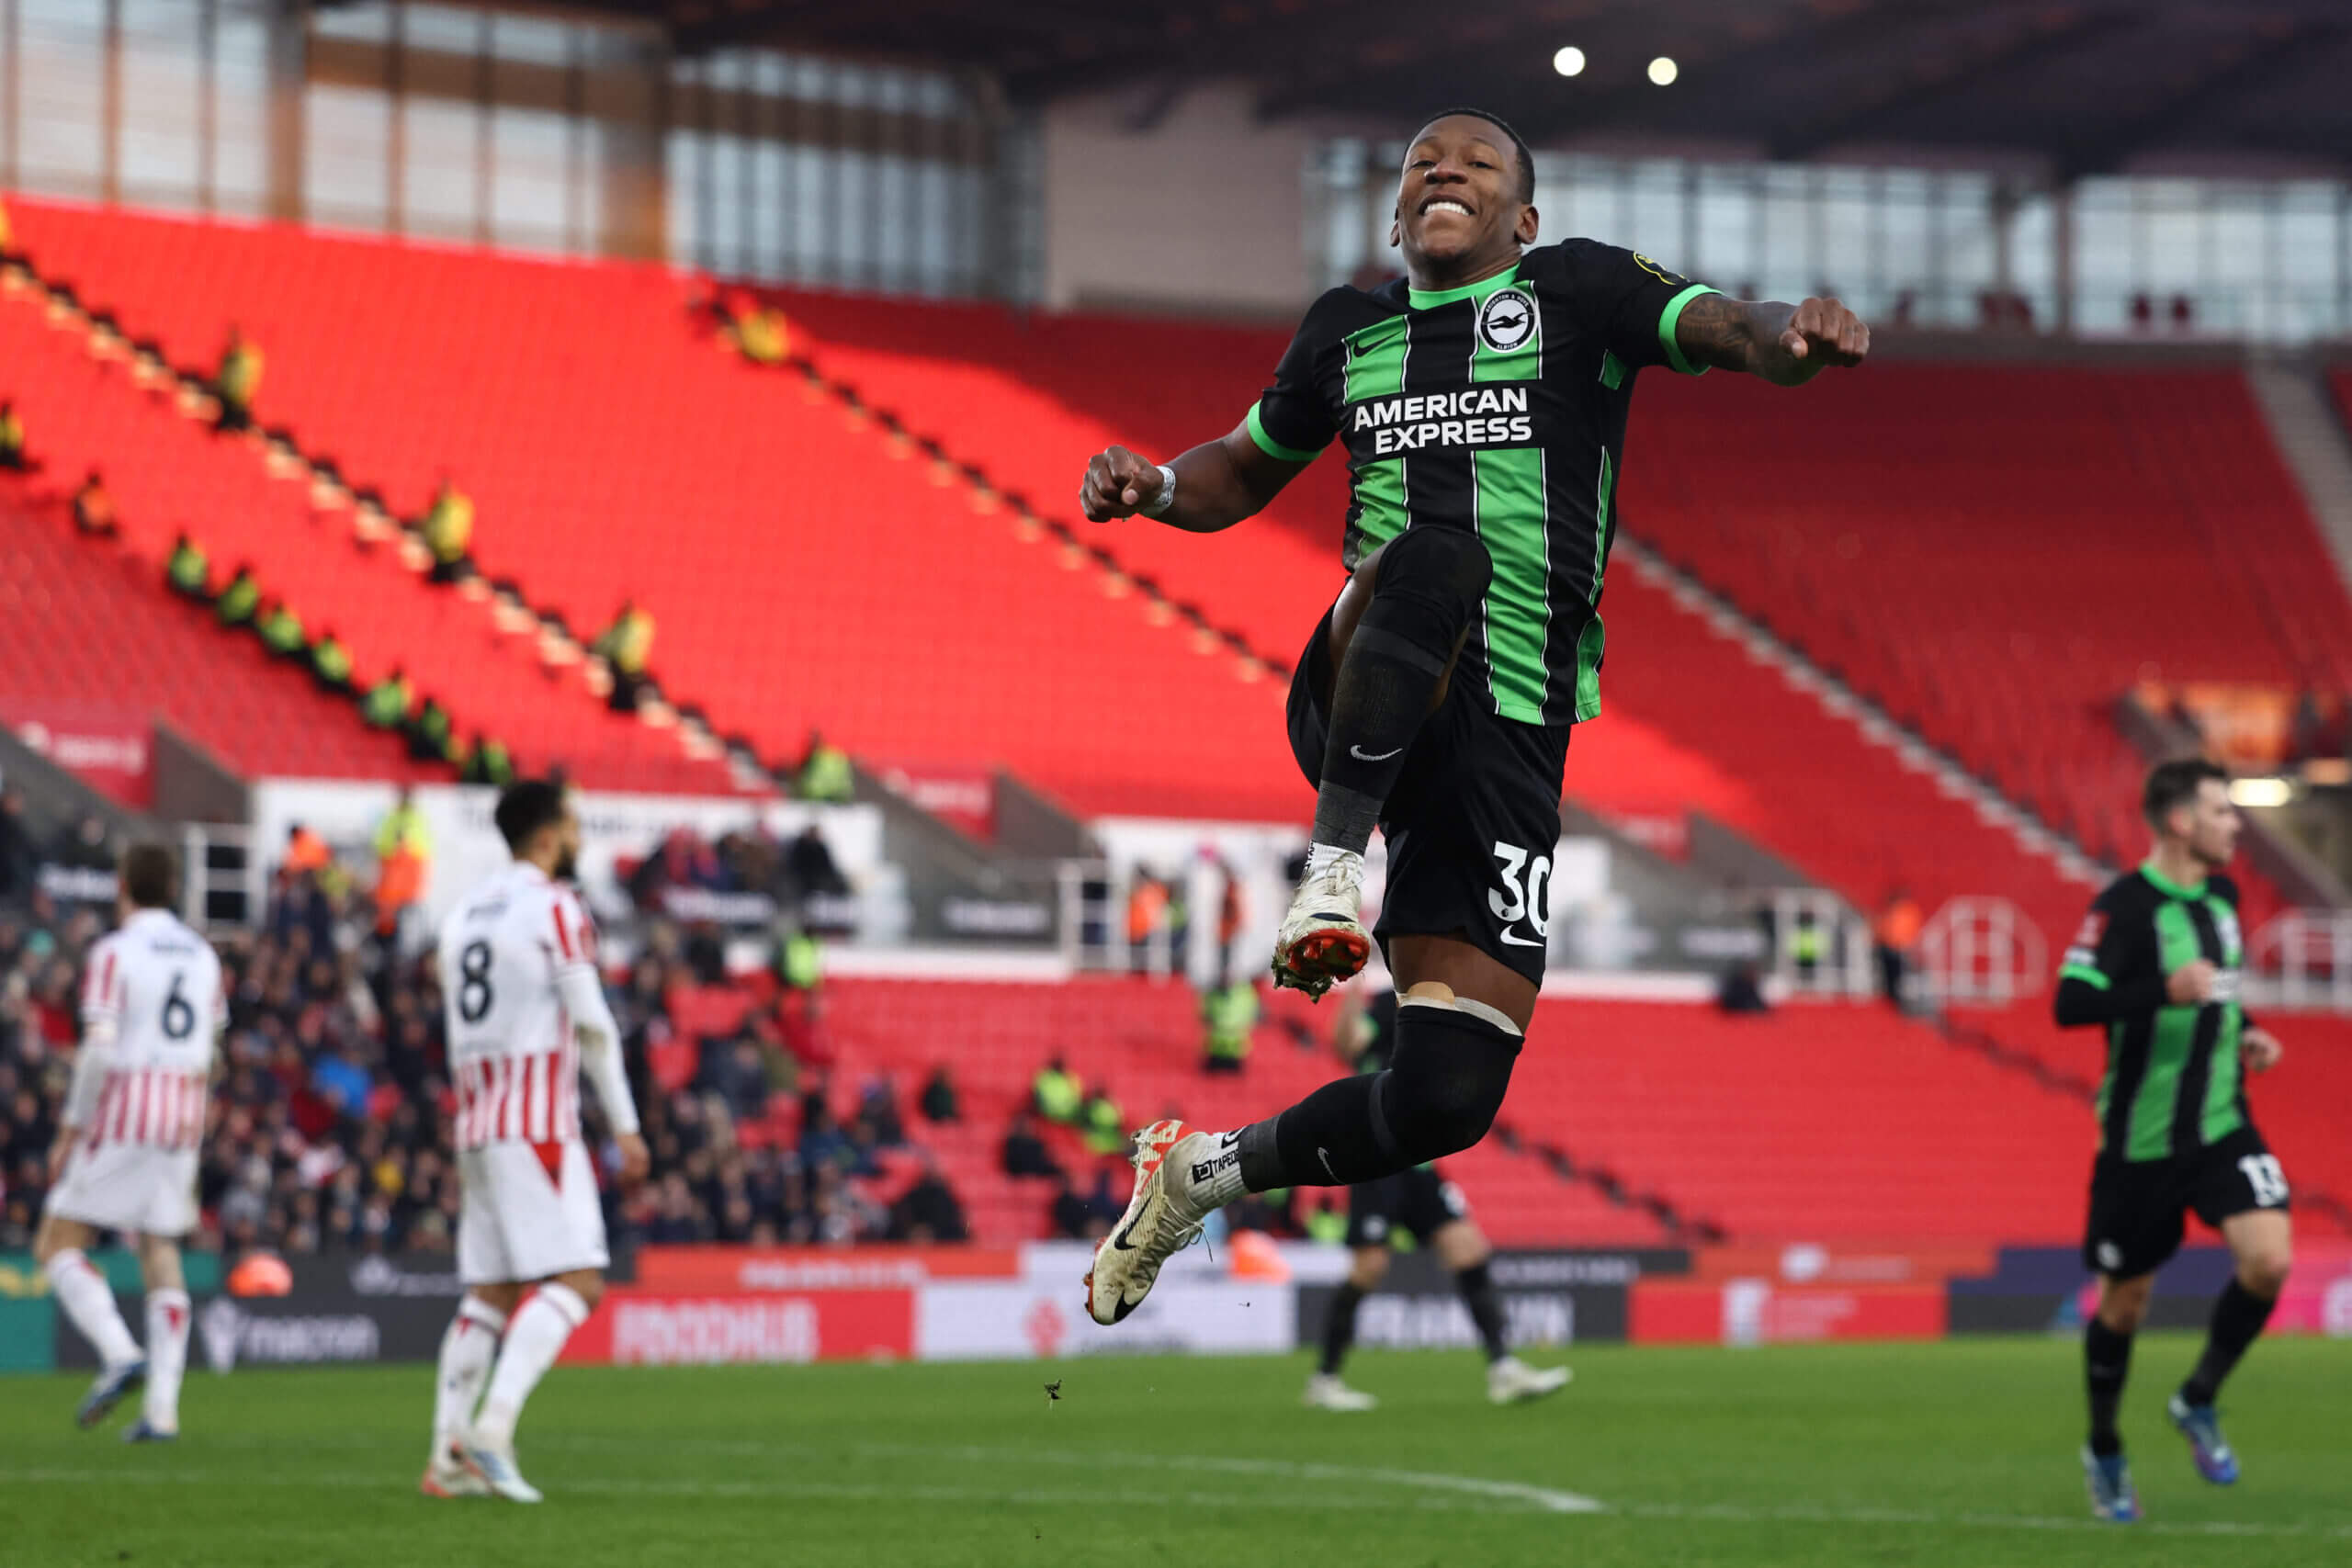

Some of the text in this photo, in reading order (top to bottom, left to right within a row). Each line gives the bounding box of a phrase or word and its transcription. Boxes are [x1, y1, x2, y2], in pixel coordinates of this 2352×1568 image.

[1354, 388, 1527, 433] AMERICAN
[1375, 416, 1532, 455] EXPRESS
[1488, 840, 1550, 937] 30
[160, 970, 195, 1041] 6
[459, 939, 493, 1025] 8
